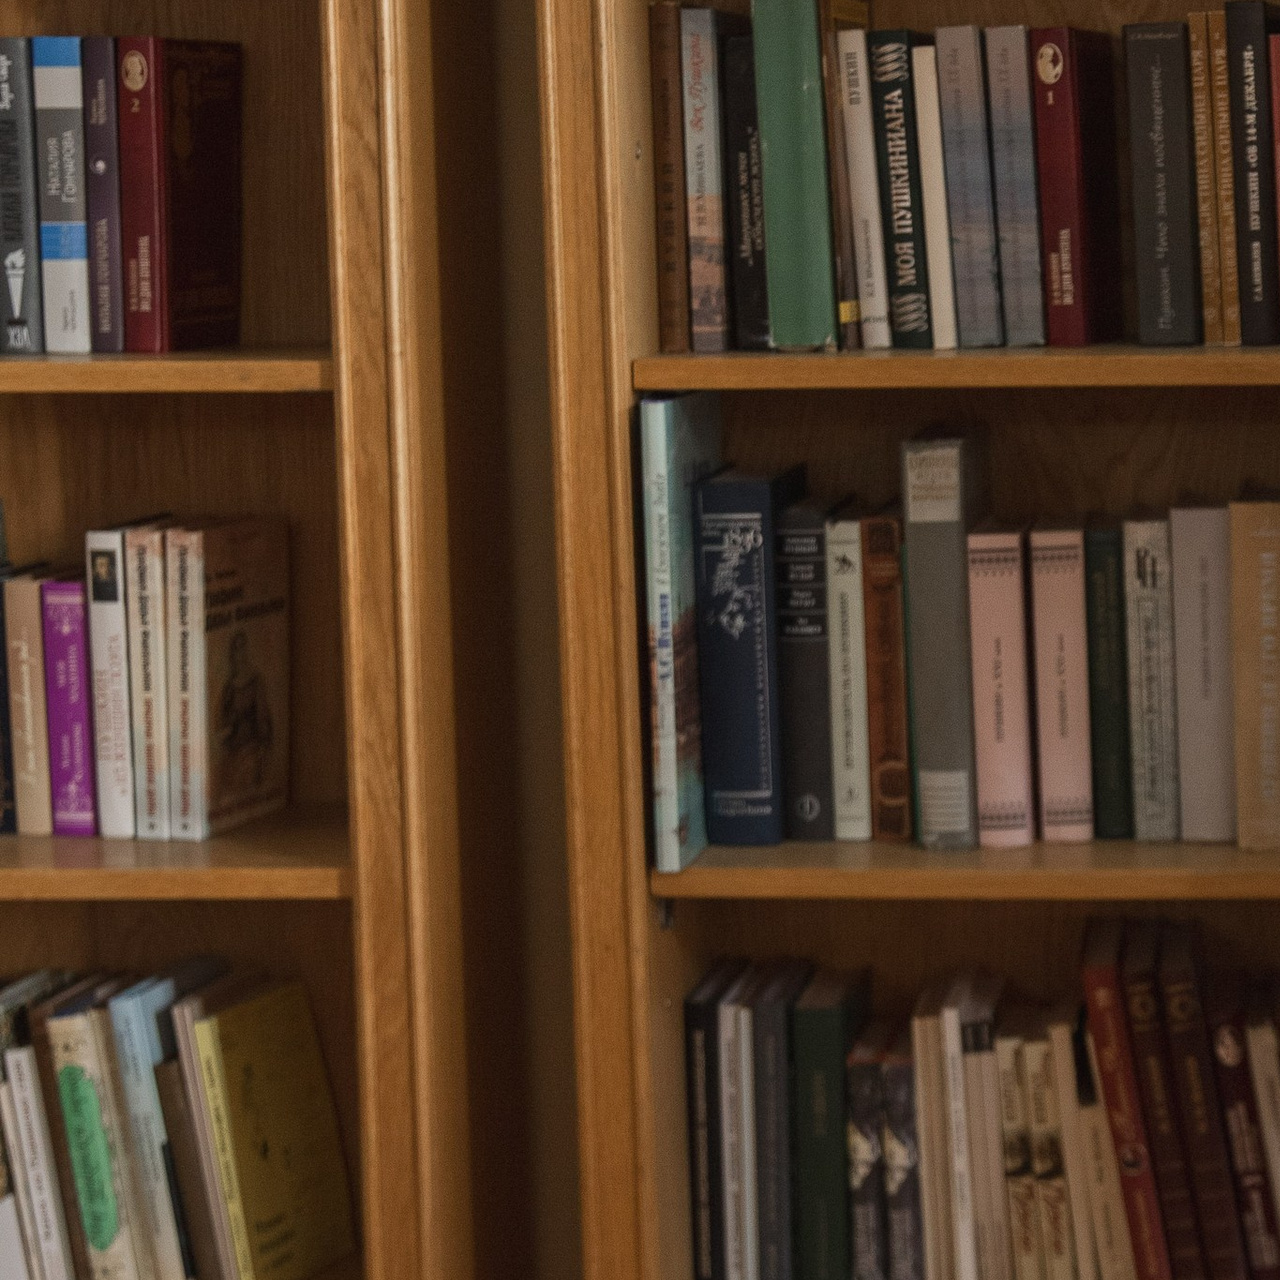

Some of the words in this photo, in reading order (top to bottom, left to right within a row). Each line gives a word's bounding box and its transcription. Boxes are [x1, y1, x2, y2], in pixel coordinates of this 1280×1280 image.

[845, 52, 861, 105] ПУШКИН
[883, 89, 913, 234] ПУШКИНИАНА
[1249, 172, 1261, 230] ПУШКИН
[894, 241, 916, 286] МОЯ
